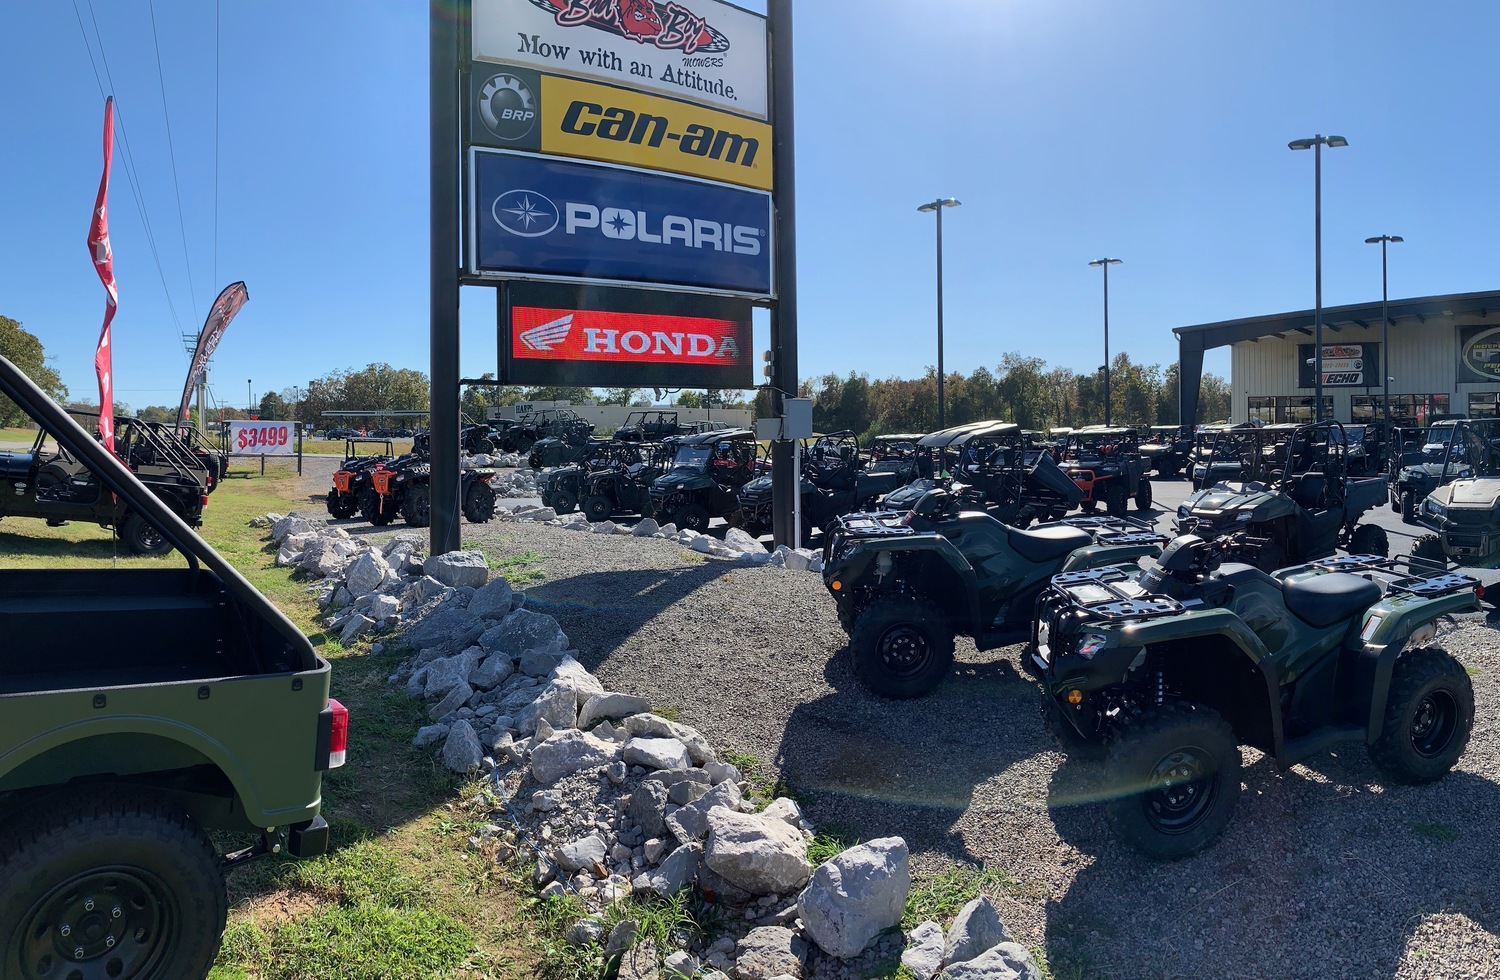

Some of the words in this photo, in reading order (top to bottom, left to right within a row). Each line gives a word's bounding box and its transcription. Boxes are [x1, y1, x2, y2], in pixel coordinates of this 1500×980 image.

[656, 6, 705, 52] Boy
[517, 32, 570, 61] Mow
[579, 48, 622, 72] with
[629, 60, 653, 79] an
[660, 63, 738, 101] Attitude.
[682, 57, 724, 68] MOWERS
[501, 108, 534, 121] BRP
[566, 202, 761, 256] POLARIS
[583, 327, 741, 359] HONDA
[1326, 373, 1360, 384] ECHO
[238, 426, 288, 449] $3499
